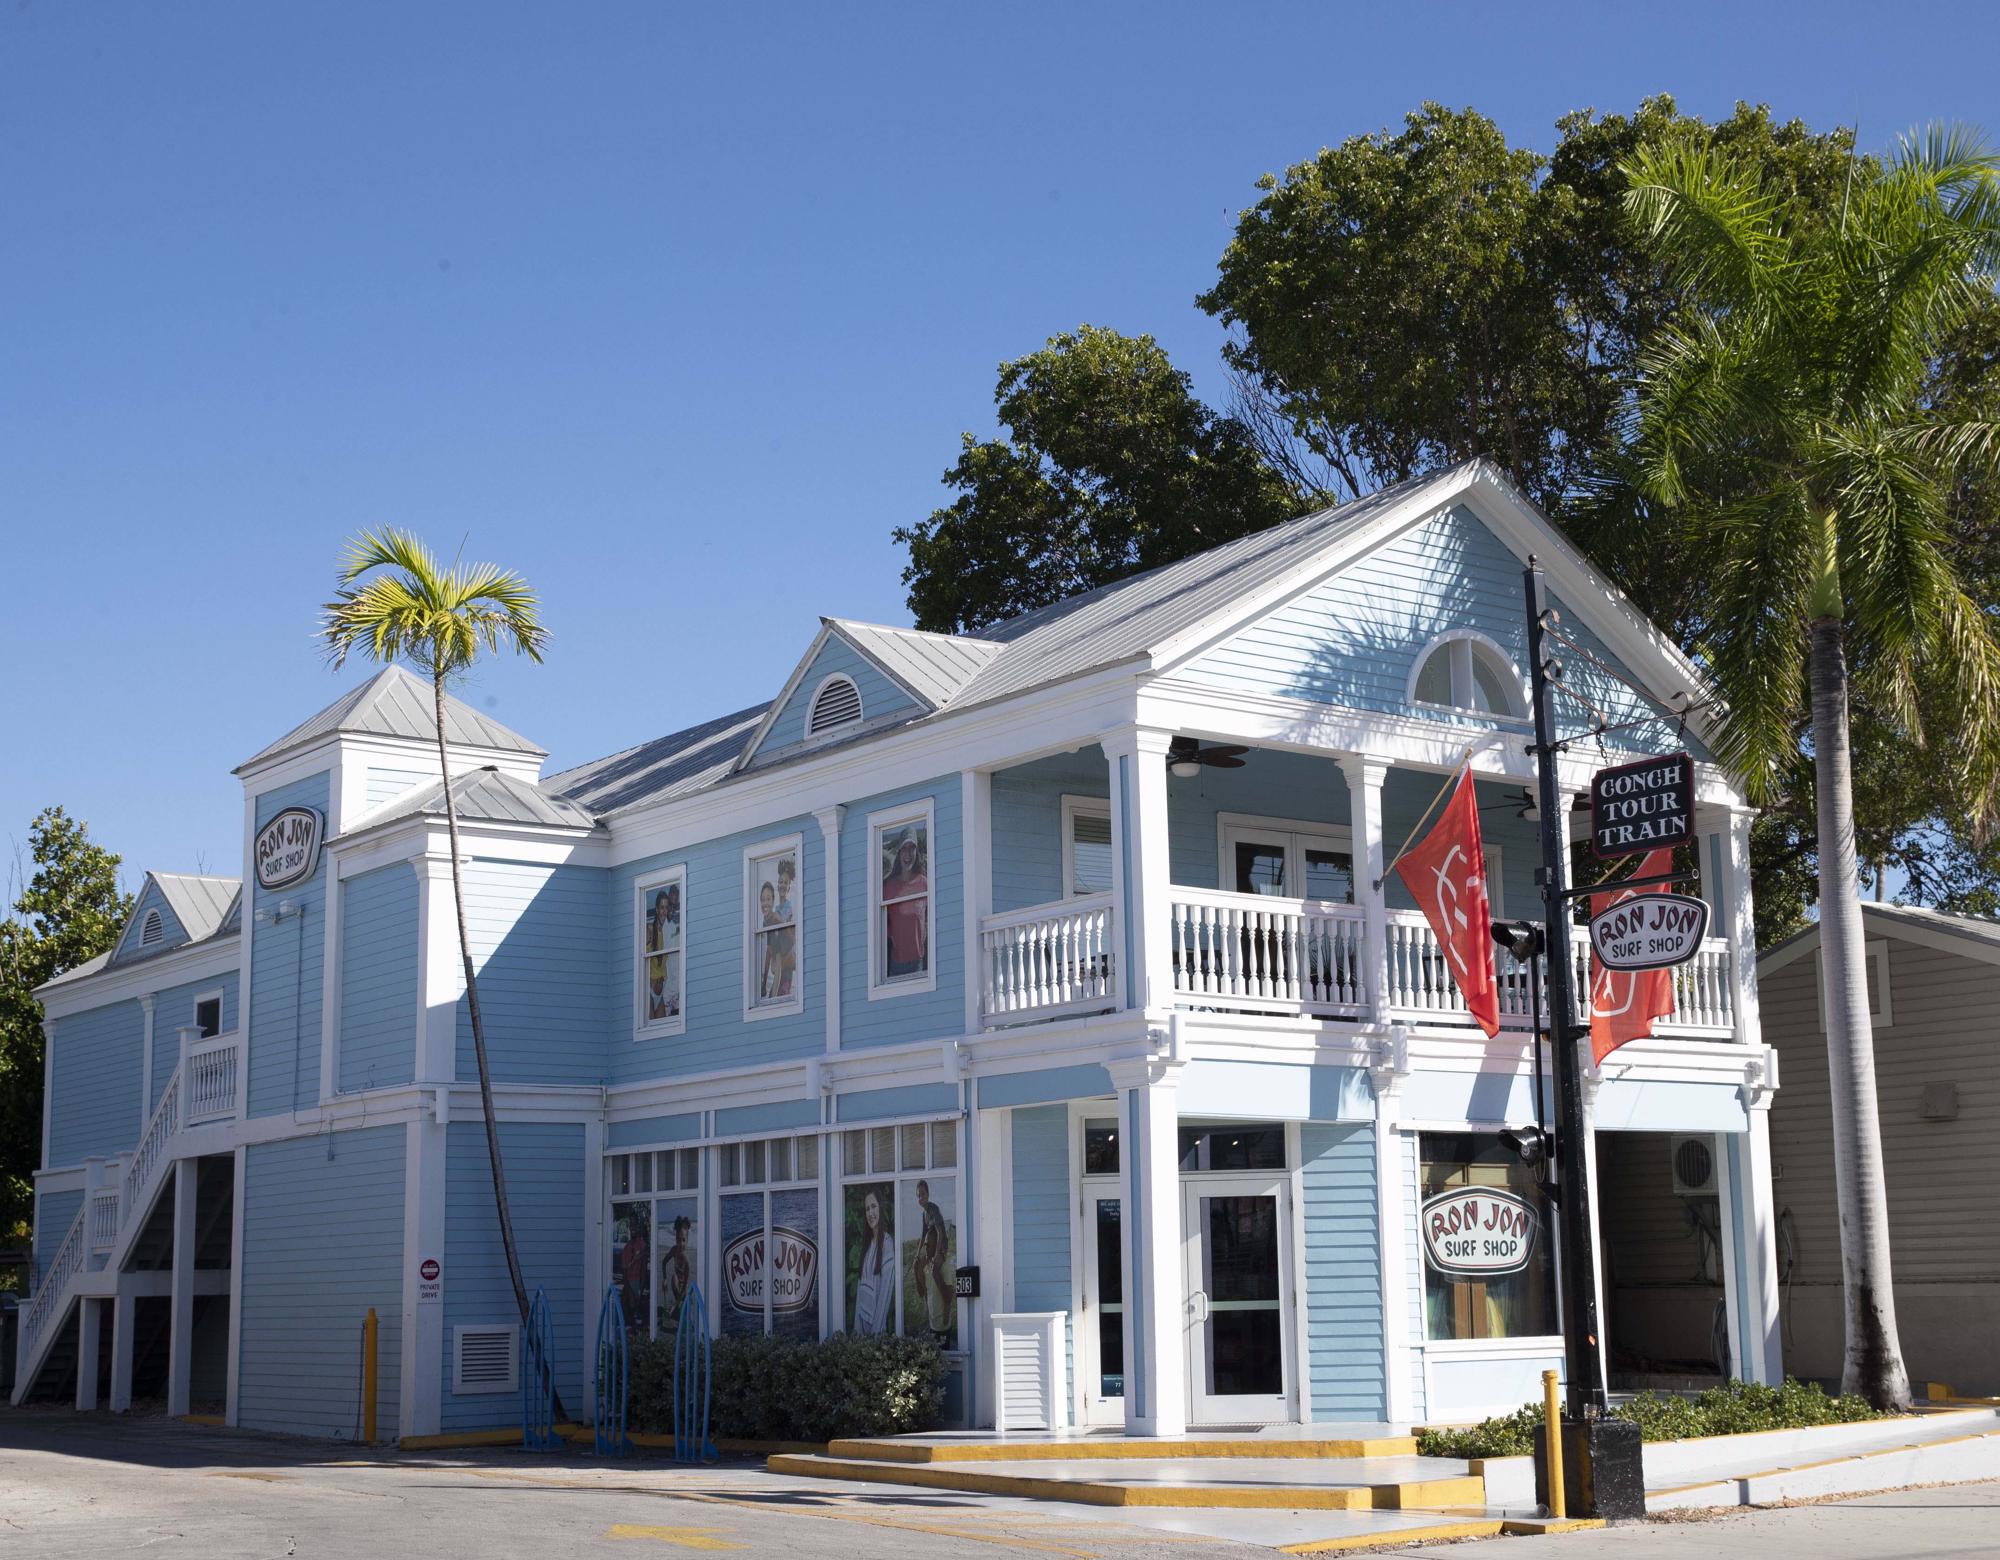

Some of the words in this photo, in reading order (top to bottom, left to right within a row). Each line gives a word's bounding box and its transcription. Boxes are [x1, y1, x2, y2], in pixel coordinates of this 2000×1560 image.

[1600, 765, 1683, 798] CONCH
[1603, 792, 1680, 821] TOUR
[260, 819, 285, 866] RON
[287, 818, 312, 846] JON
[1598, 815, 1687, 846] TRAIN
[266, 856, 282, 876] SURF
[286, 849, 304, 869] SHOP
[1600, 906, 1644, 947] RON
[1650, 905, 1698, 934] JON
[1613, 941, 1642, 958] SURF
[1649, 937, 1683, 953] SHOP
[1432, 1201, 1478, 1243] RON
[1484, 1203, 1530, 1239] JON
[731, 1240, 764, 1282] RON
[775, 1241, 812, 1276] JON
[1445, 1240, 1476, 1257] SURF
[1484, 1240, 1517, 1256] SHOP
[740, 1280, 763, 1296] SURF
[774, 1279, 800, 1295] SHOP
[956, 1278, 970, 1292] 503
